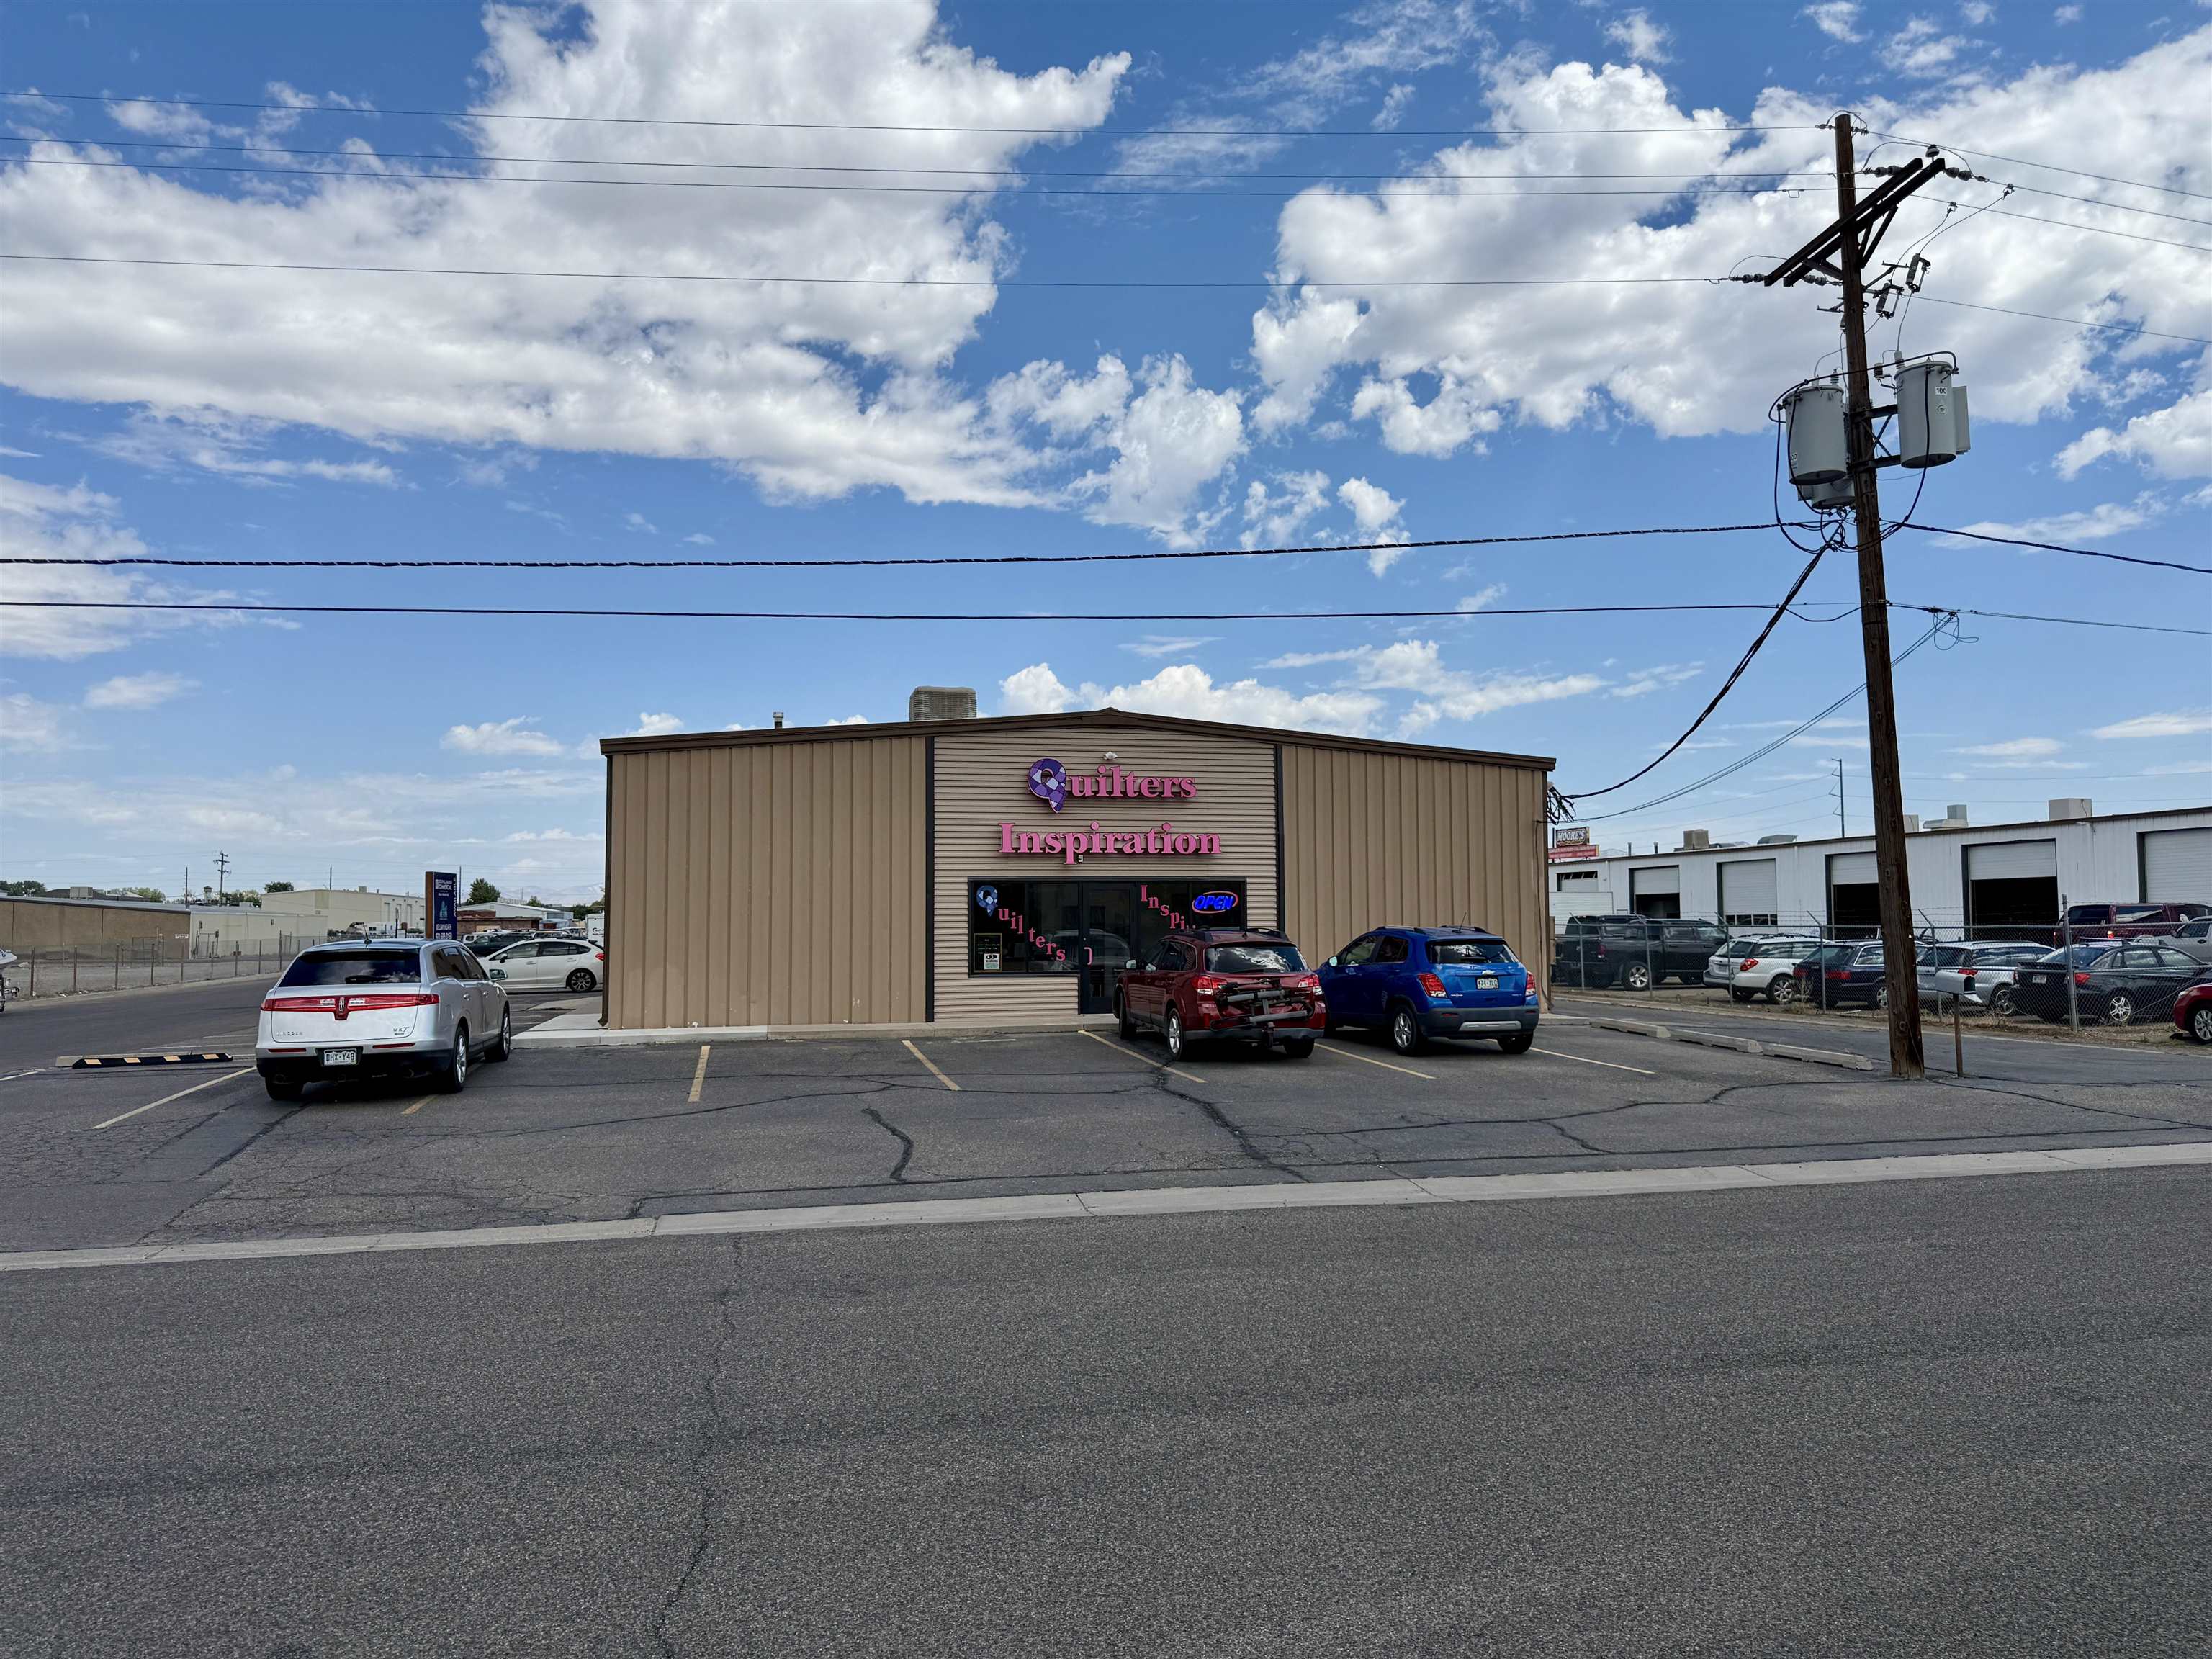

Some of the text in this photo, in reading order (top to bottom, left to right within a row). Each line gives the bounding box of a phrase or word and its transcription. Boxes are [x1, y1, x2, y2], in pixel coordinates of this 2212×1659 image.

[1028, 757, 1198, 814] Quilters
[997, 820, 1222, 865] Inspiration
[1557, 830, 1586, 841] MOORE'S
[976, 885, 1066, 961] Quilters
[1140, 884, 1196, 929] Inspi
[1194, 895, 1234, 910] OPEN
